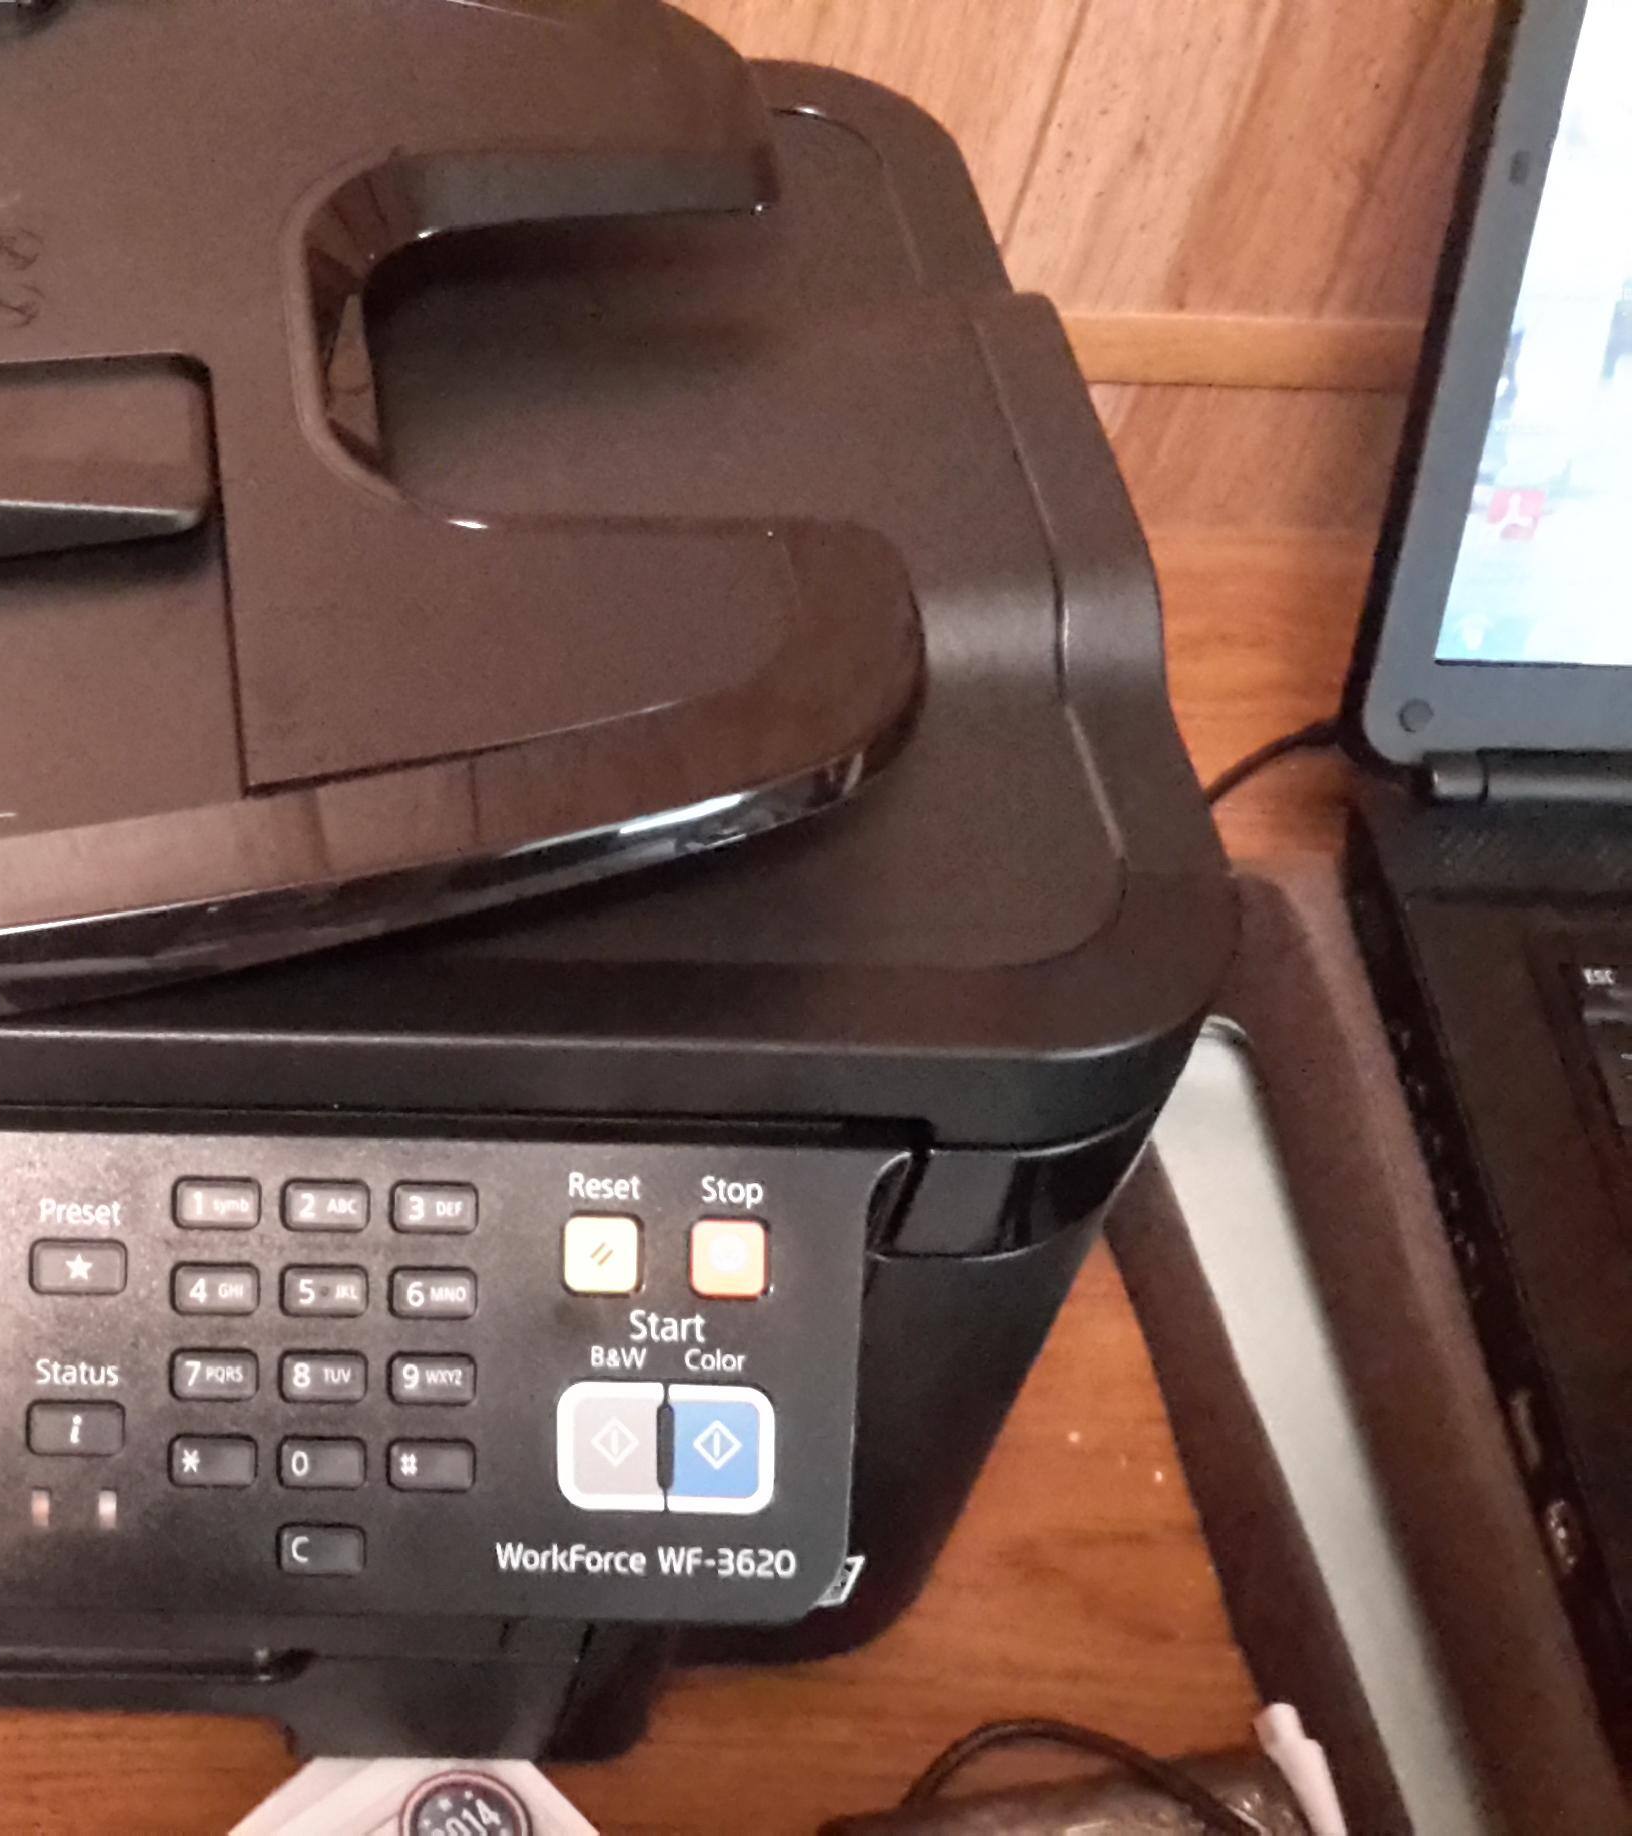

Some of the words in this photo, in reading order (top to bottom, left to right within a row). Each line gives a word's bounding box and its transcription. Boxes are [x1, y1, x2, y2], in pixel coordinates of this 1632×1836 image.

[568, 1171, 641, 1200] Reset
[701, 1175, 764, 1209] Stop
[38, 1197, 121, 1227] Preset
[194, 1190, 204, 1216] 1
[299, 1192, 316, 1219] 2
[326, 1197, 357, 1215] ABC
[408, 1195, 425, 1221] 3
[435, 1200, 463, 1217] DEF
[188, 1277, 208, 1303] 4
[217, 1282, 245, 1299] GHI
[299, 1278, 315, 1305] 5
[335, 1284, 359, 1300] JKL
[407, 1281, 425, 1307] 6
[430, 1286, 467, 1302] MNO
[629, 1309, 706, 1343] Start
[590, 1345, 647, 1370] B&W
[684, 1347, 746, 1372] Color
[35, 1358, 119, 1387] Status
[184, 1360, 201, 1386] 7
[206, 1366, 244, 1384] PQRS
[293, 1363, 311, 1388] 8
[322, 1367, 351, 1384] TUV
[402, 1363, 420, 1390] 9
[425, 1369, 463, 1386] WXYZ
[292, 1536, 309, 1563] C
[495, 1542, 647, 1574] WorkForce
[657, 1546, 797, 1578] WF-3620
[430, 1798, 501, 1836] 014
